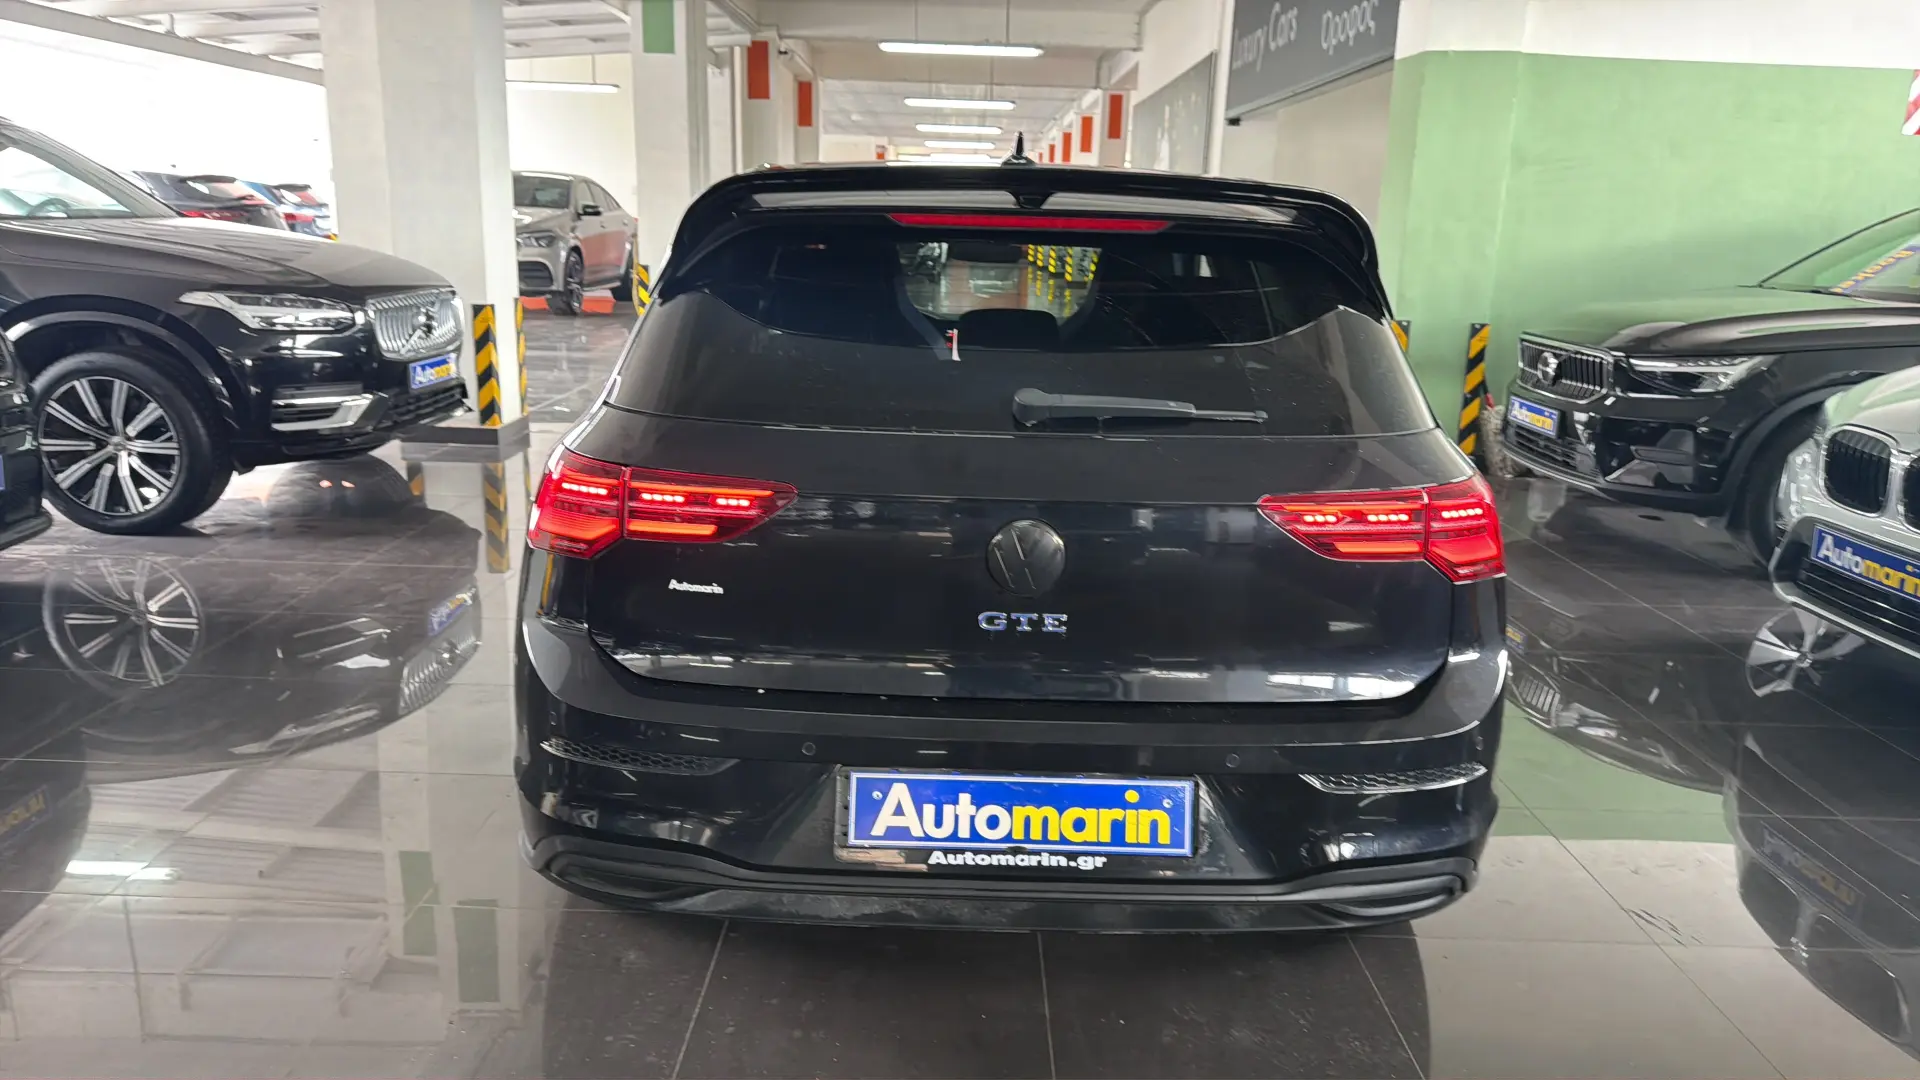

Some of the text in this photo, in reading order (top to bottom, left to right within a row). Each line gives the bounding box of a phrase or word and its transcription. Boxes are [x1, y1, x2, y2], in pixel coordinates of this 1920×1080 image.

[1269, 2, 1298, 51] Cars
[978, 611, 1068, 633] GTE
[870, 783, 1170, 844] Automarin
[928, 850, 1107, 870] Automarin.gr
